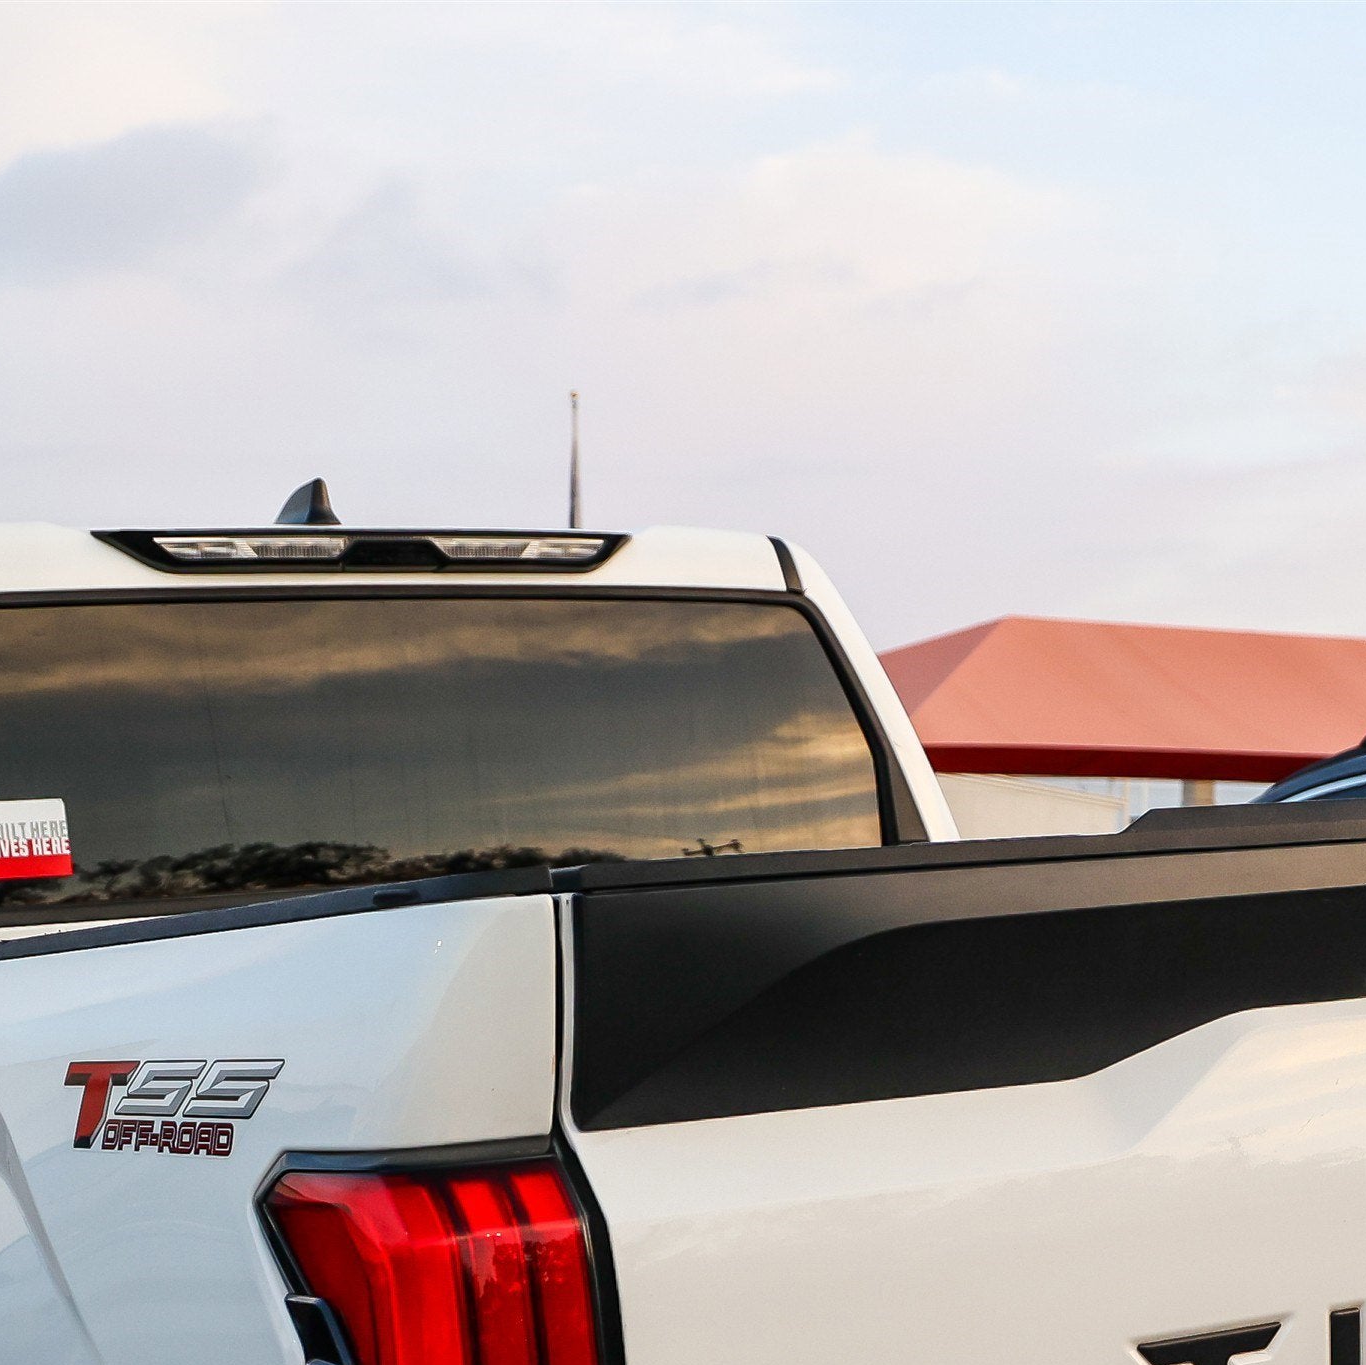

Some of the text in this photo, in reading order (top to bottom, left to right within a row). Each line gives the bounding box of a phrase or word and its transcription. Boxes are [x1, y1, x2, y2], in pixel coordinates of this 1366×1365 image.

[30, 820, 68, 839] HERE
[31, 837, 71, 856] HERE
[101, 1118, 235, 1157] OFF-ROAD
